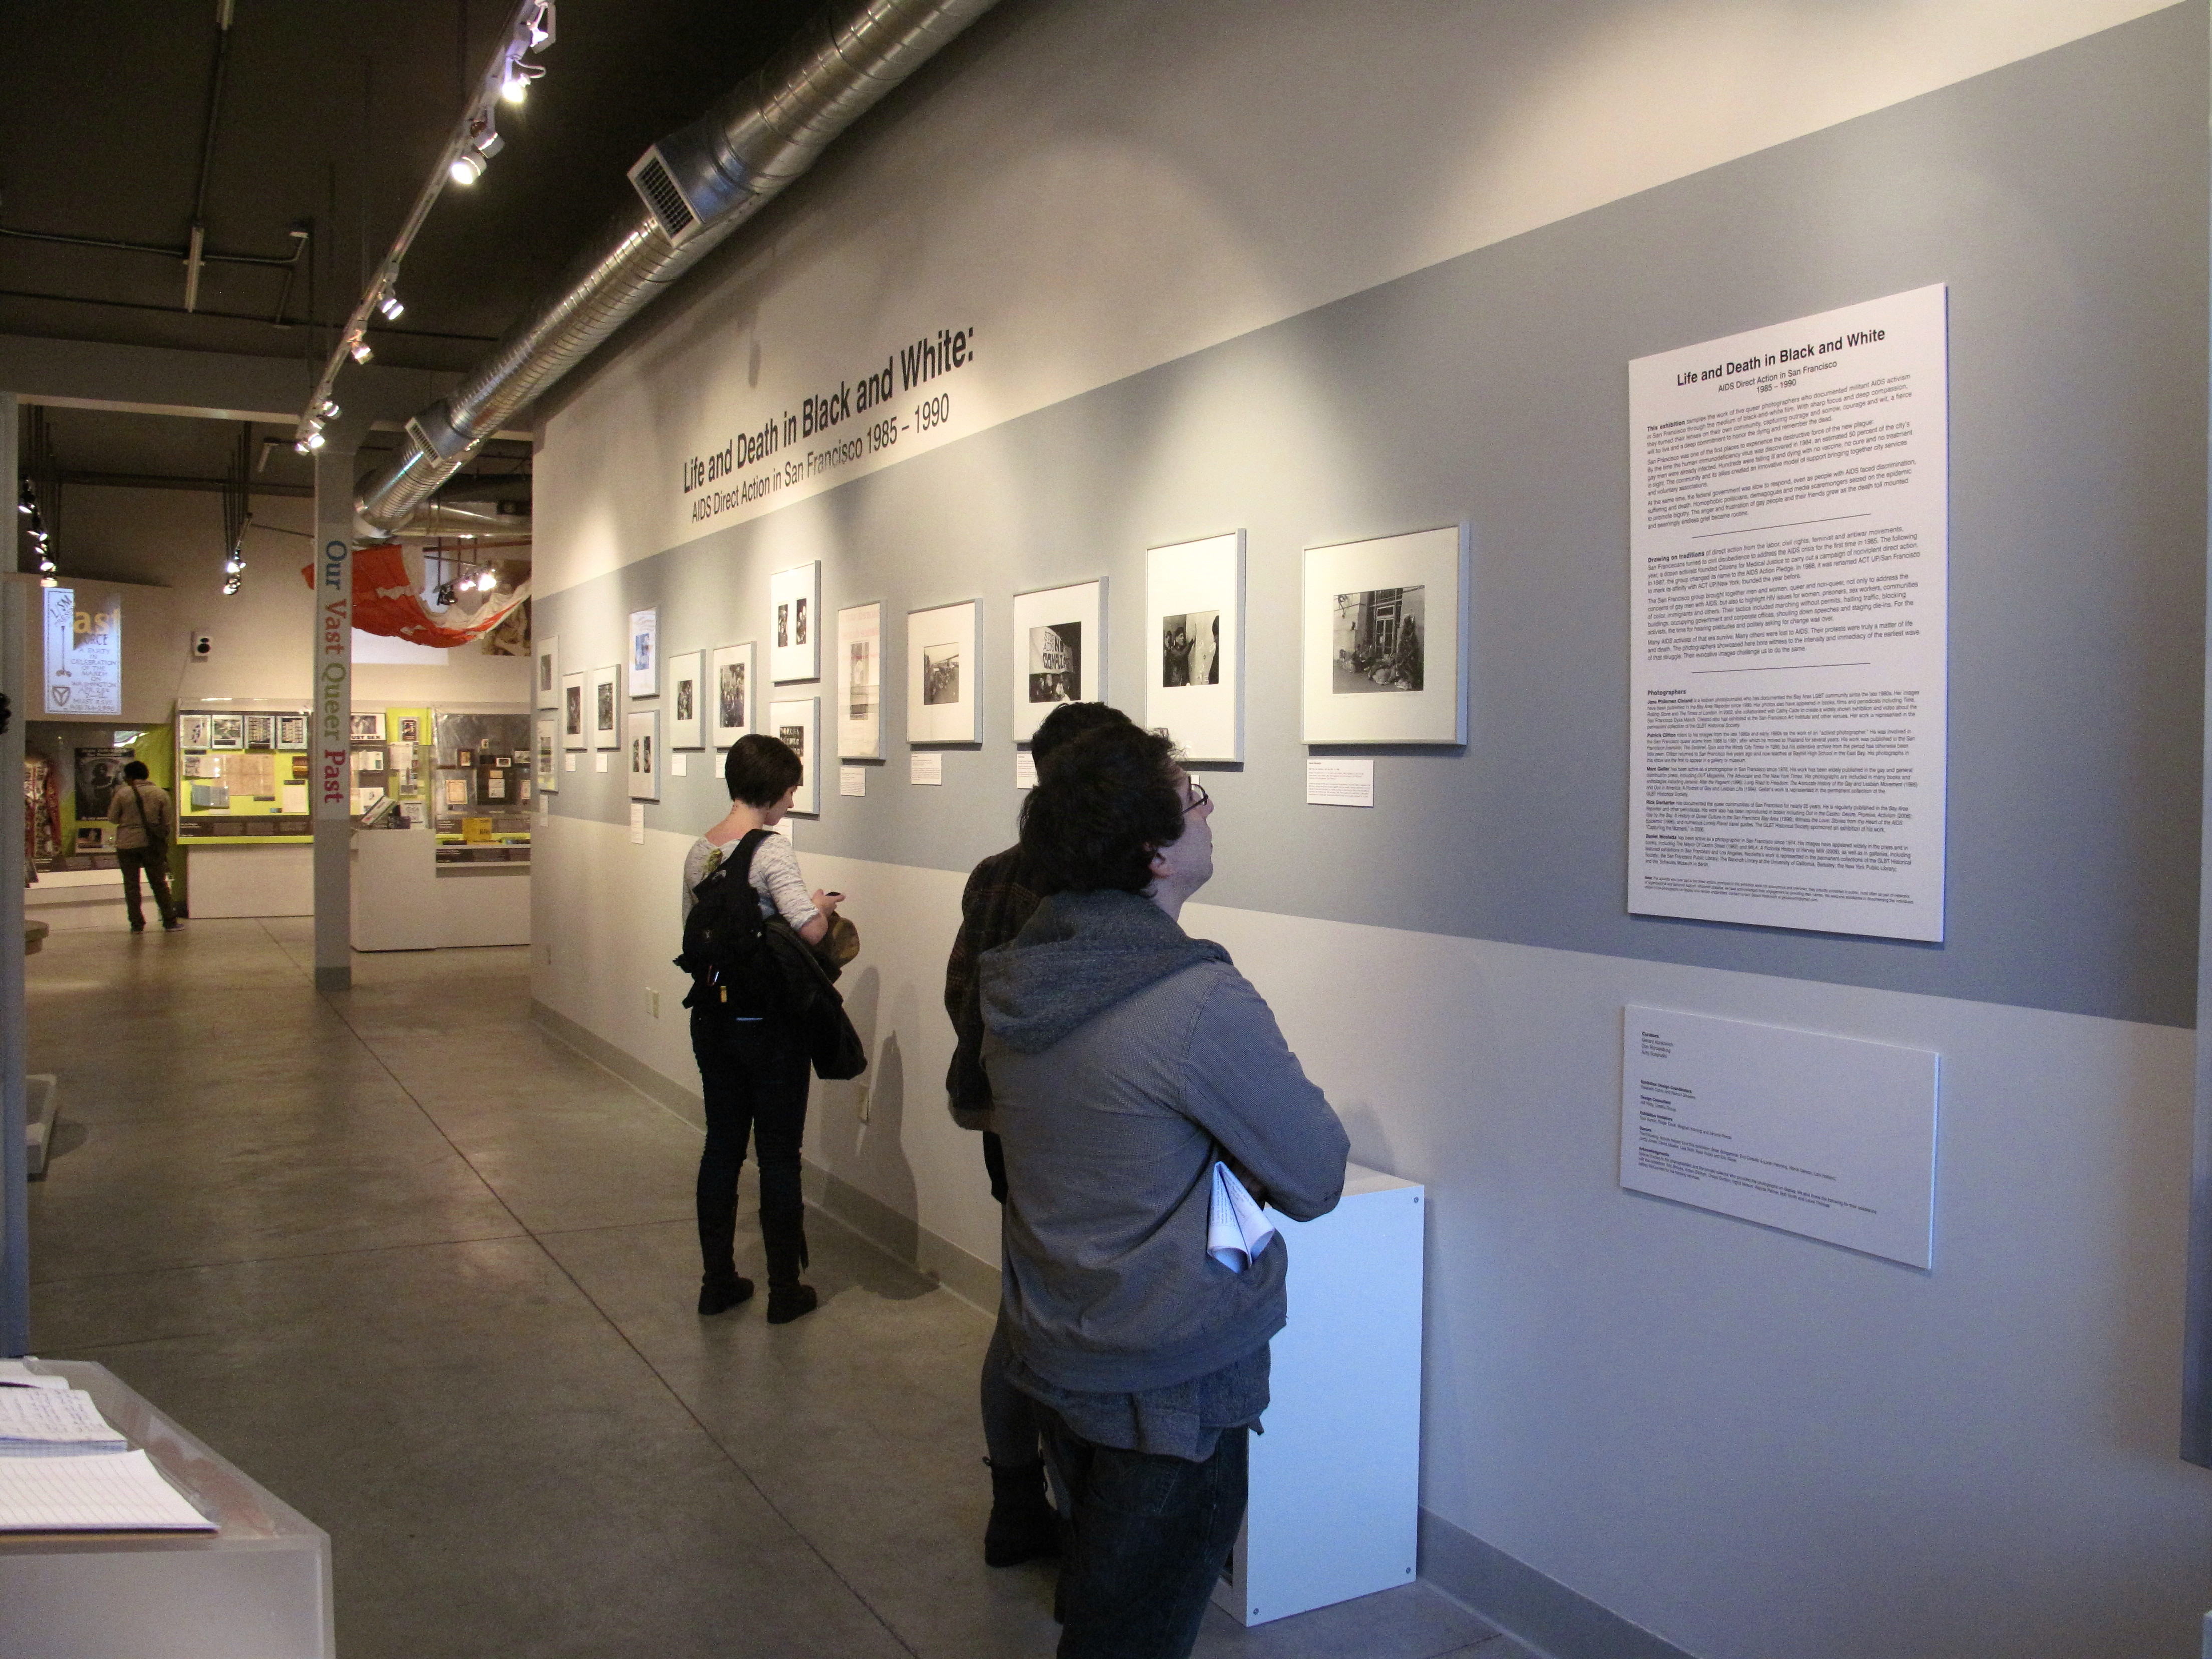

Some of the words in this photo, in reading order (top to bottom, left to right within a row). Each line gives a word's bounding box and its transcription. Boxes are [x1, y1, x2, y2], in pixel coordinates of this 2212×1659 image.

[1677, 372, 1697, 386] Life
[1701, 365, 1723, 380] and
[1726, 356, 1761, 375] Death
[1764, 354, 1775, 366] in
[1779, 344, 1814, 363] Black
[1818, 337, 1843, 354] and
[1847, 329, 1885, 347] White
[1718, 382, 1735, 392] AIDS
[1735, 378, 1755, 388] Direct
[1756, 374, 1778, 384] Action
[1787, 369, 1801, 377] San
[1802, 361, 1837, 374] Francisco
[684, 455, 705, 494] Life
[708, 439, 732, 483] and
[737, 415, 779, 470] Death
[783, 411, 797, 448] in
[802, 380, 850, 439] Black
[857, 355, 893, 414] and
[900, 327, 974, 392] White:
[1756, 384, 1773, 394] 1985
[1780, 379, 1796, 389] 1990
[1659, 420, 1685, 429] exhibition
[691, 494, 712, 524] AIDS
[714, 480, 739, 516] Direct
[741, 467, 771, 504] Action
[773, 467, 782, 493] in
[784, 457, 804, 488] San
[807, 436, 863, 479] Francisco
[867, 415, 898, 452] 1985
[914, 393, 950, 434] 1990
[325, 540, 348, 591] Our
[325, 598, 348, 655] Vast
[321, 662, 347, 741] Queer
[324, 749, 347, 803] Past
